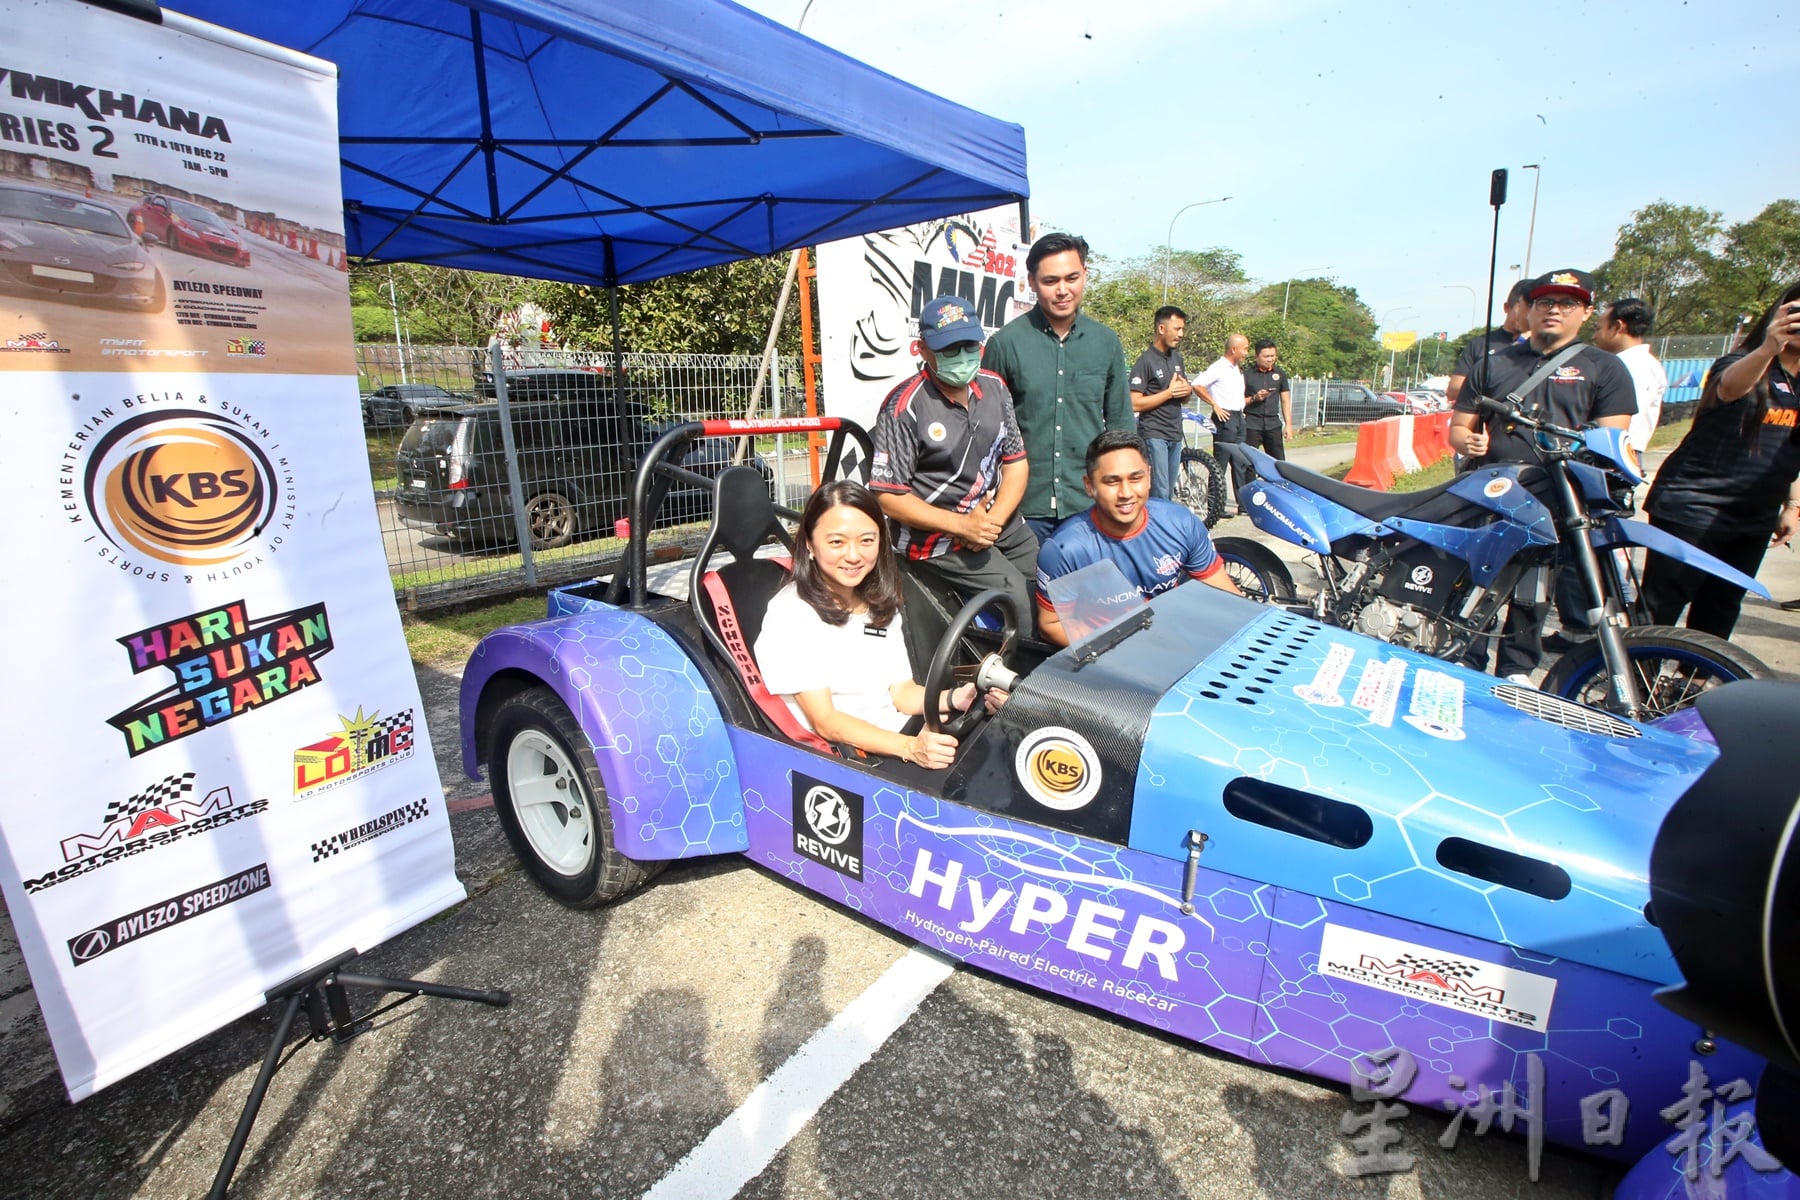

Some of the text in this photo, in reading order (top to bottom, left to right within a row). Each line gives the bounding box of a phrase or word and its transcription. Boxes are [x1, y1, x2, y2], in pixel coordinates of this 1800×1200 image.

[87, 125, 119, 158] 2
[134, 132, 158, 147] 17TH
[160, 140, 168, 149] &
[193, 147, 212, 159] DEC
[214, 151, 226, 162] 22
[182, 160, 202, 172] 7AM
[208, 165, 229, 178] 5PM
[173, 280, 263, 299] AYLEZO SPEEDWAY
[985, 250, 1016, 278] 202
[60, 391, 270, 523] KEMENTERIAN BELIA & SUKAN
[150, 469, 249, 508] KBS
[98, 456, 297, 584] MINISTRY OF YOUTH & SPORTS
[1404, 581, 1433, 595] REVIVE
[128, 604, 246, 669] HARI
[175, 612, 328, 693] SUKAN
[718, 605, 761, 686] SCHROTH
[124, 656, 316, 751] NEGARA
[318, 761, 386, 792] MOTORSPORTS
[390, 751, 411, 763] CLUB
[1045, 759, 1079, 778] KBS
[23, 799, 269, 890] MOTORSPORTS
[29, 807, 269, 895] ASSOCIATION OF MALAYSIA
[60, 786, 233, 863] MAM
[338, 806, 406, 845] WHEELSPIN
[343, 821, 406, 851] MOTORSPORTS
[796, 832, 860, 875] REVIVE
[116, 867, 268, 943] AYLEZO SPEEDZONE
[909, 847, 1186, 983] HyPER
[905, 909, 1178, 1014] Hydrogen-Paired Electric Racecar
[1359, 954, 1505, 1004] MAM
[1327, 961, 1537, 1023] MOTORSPORTS
[1327, 968, 1534, 1026] ASSOCIATION OF MALAYSIA
